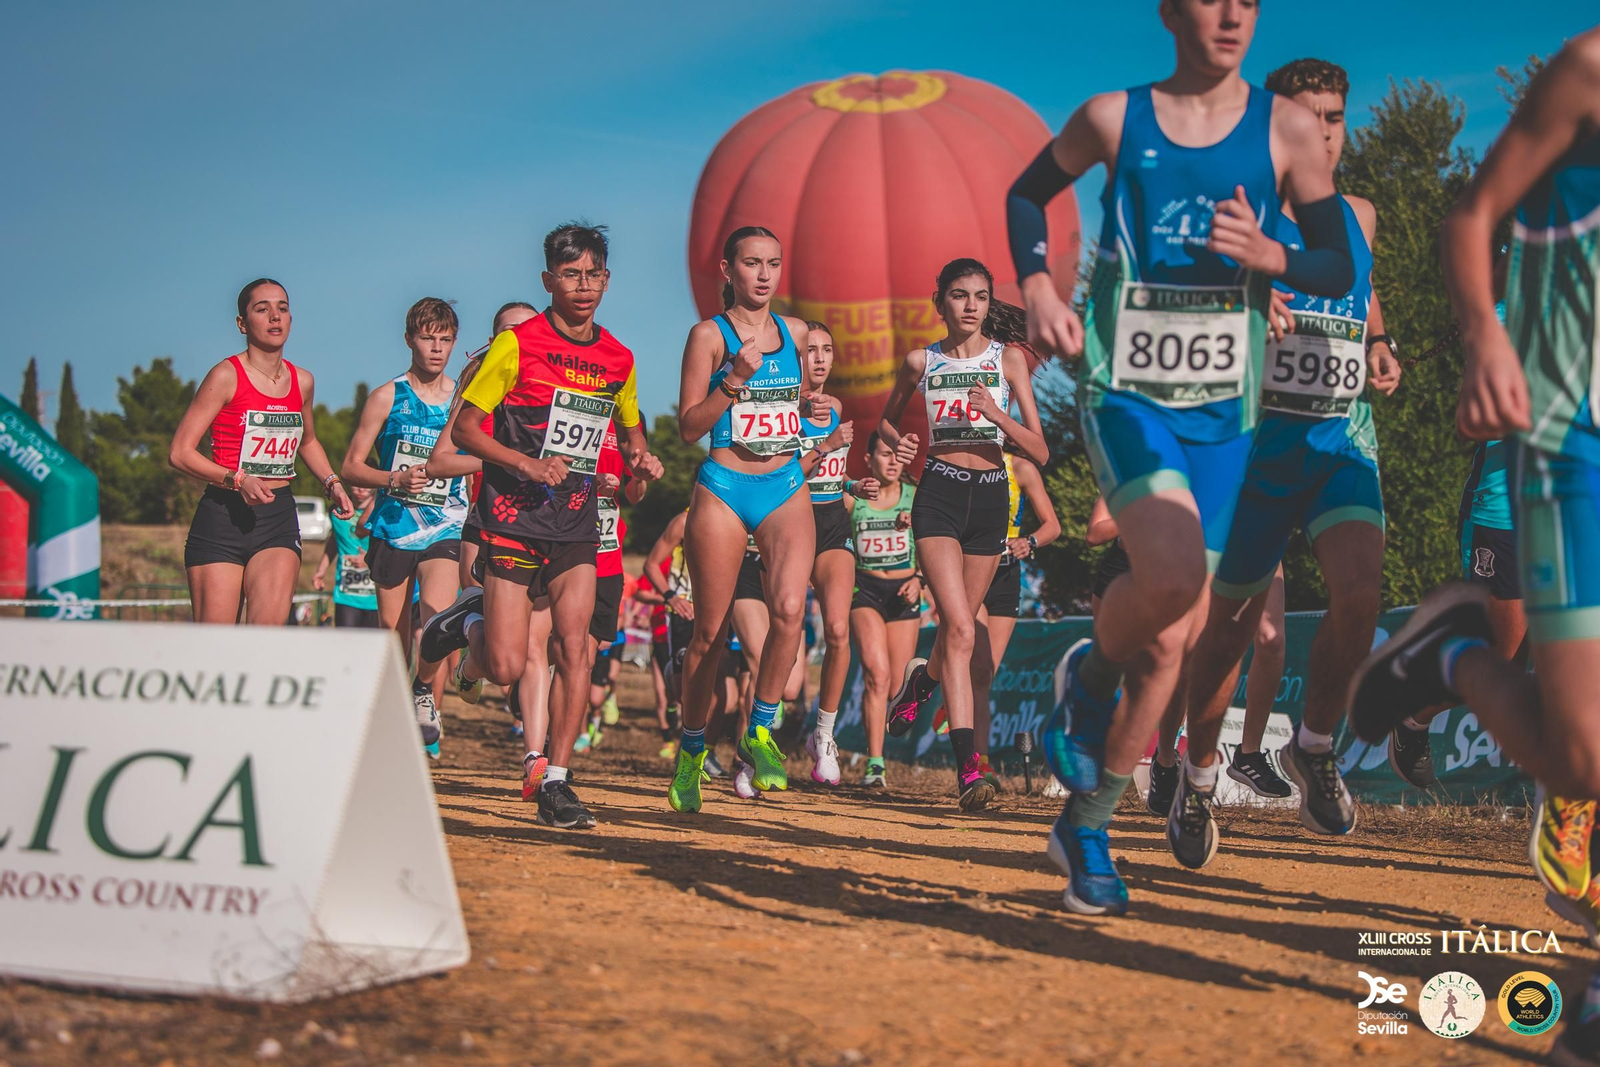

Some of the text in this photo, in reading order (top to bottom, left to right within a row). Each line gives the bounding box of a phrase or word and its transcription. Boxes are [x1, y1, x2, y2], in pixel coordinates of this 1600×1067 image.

[1128, 331, 1236, 371] 8063
[547, 352, 607, 378] Málaga
[1272, 350, 1360, 390] 5988
[565, 368, 607, 388] Bahía
[749, 376, 798, 388] TROTASIERRA
[932, 399, 996, 423] 746
[401, 425, 419, 434] CLUB
[550, 420, 603, 453] 5974
[740, 411, 799, 437] 7510
[250, 436, 298, 459] 7449
[931, 462, 972, 482] PRO
[861, 536, 906, 554] 7515
[266, 676, 325, 710] DE
[92, 876, 270, 916] COUNTRY
